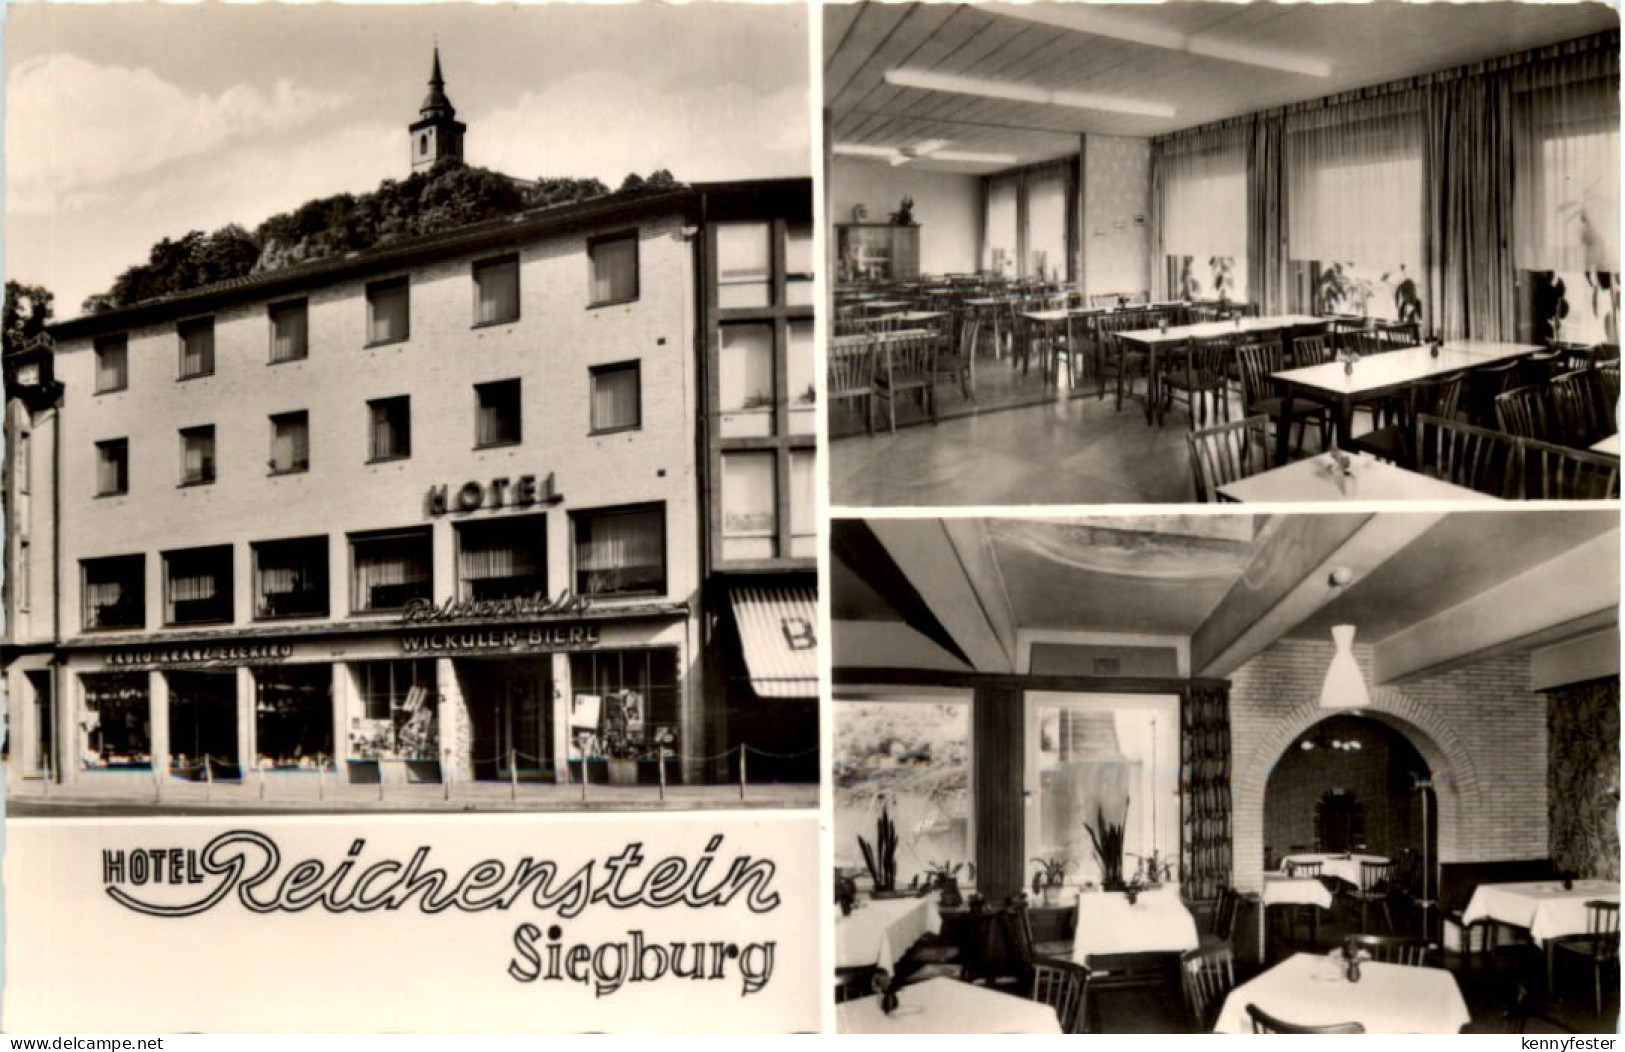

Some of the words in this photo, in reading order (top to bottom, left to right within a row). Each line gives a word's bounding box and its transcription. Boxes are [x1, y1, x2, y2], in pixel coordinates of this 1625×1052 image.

[424, 472, 564, 517] HOTEL
[102, 849, 204, 885] HOTEL
[105, 829, 781, 917] Reichenstein
[507, 922, 777, 998] Siegburg
